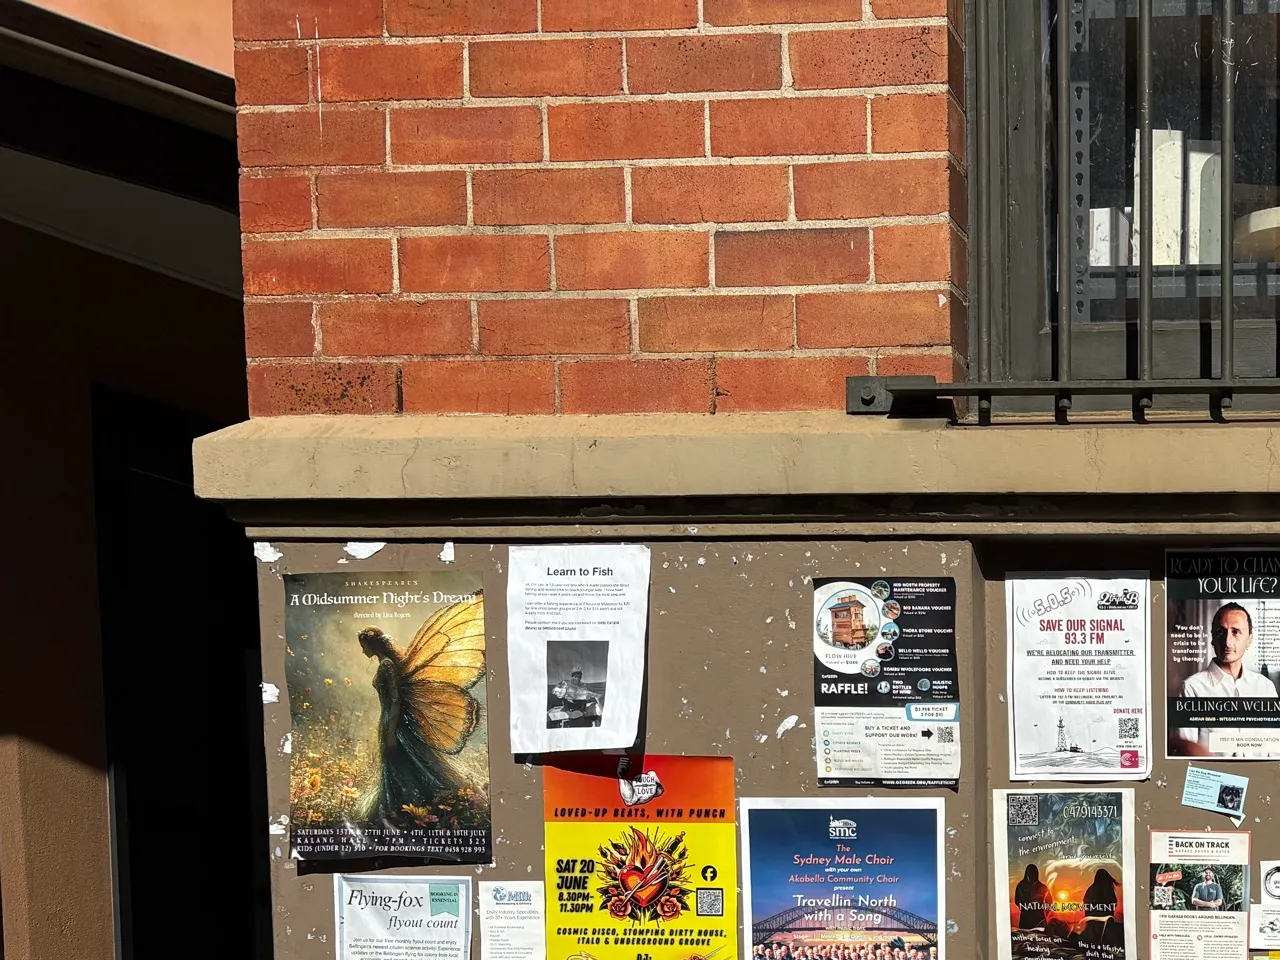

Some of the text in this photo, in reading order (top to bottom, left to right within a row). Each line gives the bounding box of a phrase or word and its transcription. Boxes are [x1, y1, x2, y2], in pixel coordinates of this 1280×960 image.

[547, 566, 613, 577] Learn to Fish
[1198, 578, 1277, 593] YOUR LIFE?
[291, 590, 476, 607] A Midsummer Night's Dream
[1039, 619, 1125, 631] SAVE OUR SIGNAL
[1065, 633, 1104, 644] 93.3 FM
[821, 683, 868, 694] RAFFLE!
[1177, 701, 1238, 712] BELLINGEN
[555, 808, 725, 818] LOVED-UP BEATS, WITH PUNCH
[1063, 806, 1117, 818] 0479143371
[556, 859, 594, 874] SAT 20
[793, 855, 894, 867] Sydney Male Choir
[557, 876, 588, 890] JUNE
[347, 889, 423, 911] Flying-fox
[858, 894, 896, 907] North
[387, 915, 458, 930] flyout count
